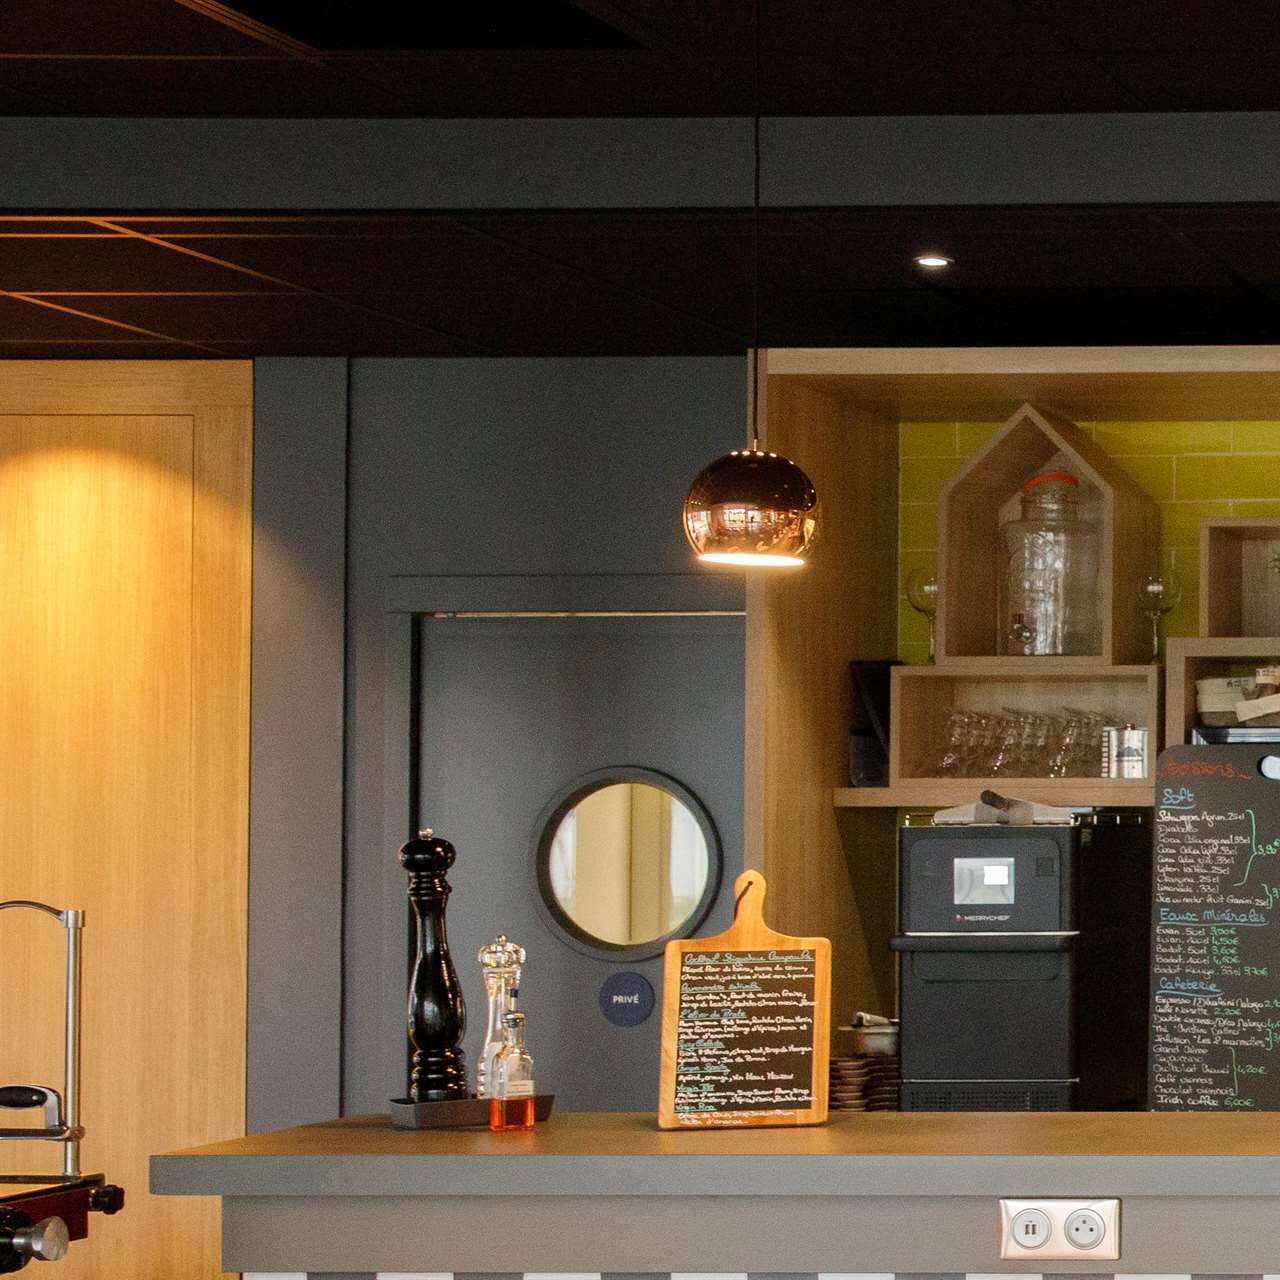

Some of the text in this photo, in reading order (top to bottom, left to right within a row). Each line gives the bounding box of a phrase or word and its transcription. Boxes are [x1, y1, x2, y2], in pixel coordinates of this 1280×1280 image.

[1162, 787, 1195, 804] Soft
[1160, 907, 1266, 922] Eaux Minérales
[612, 993, 640, 1004] PRIVÉ
